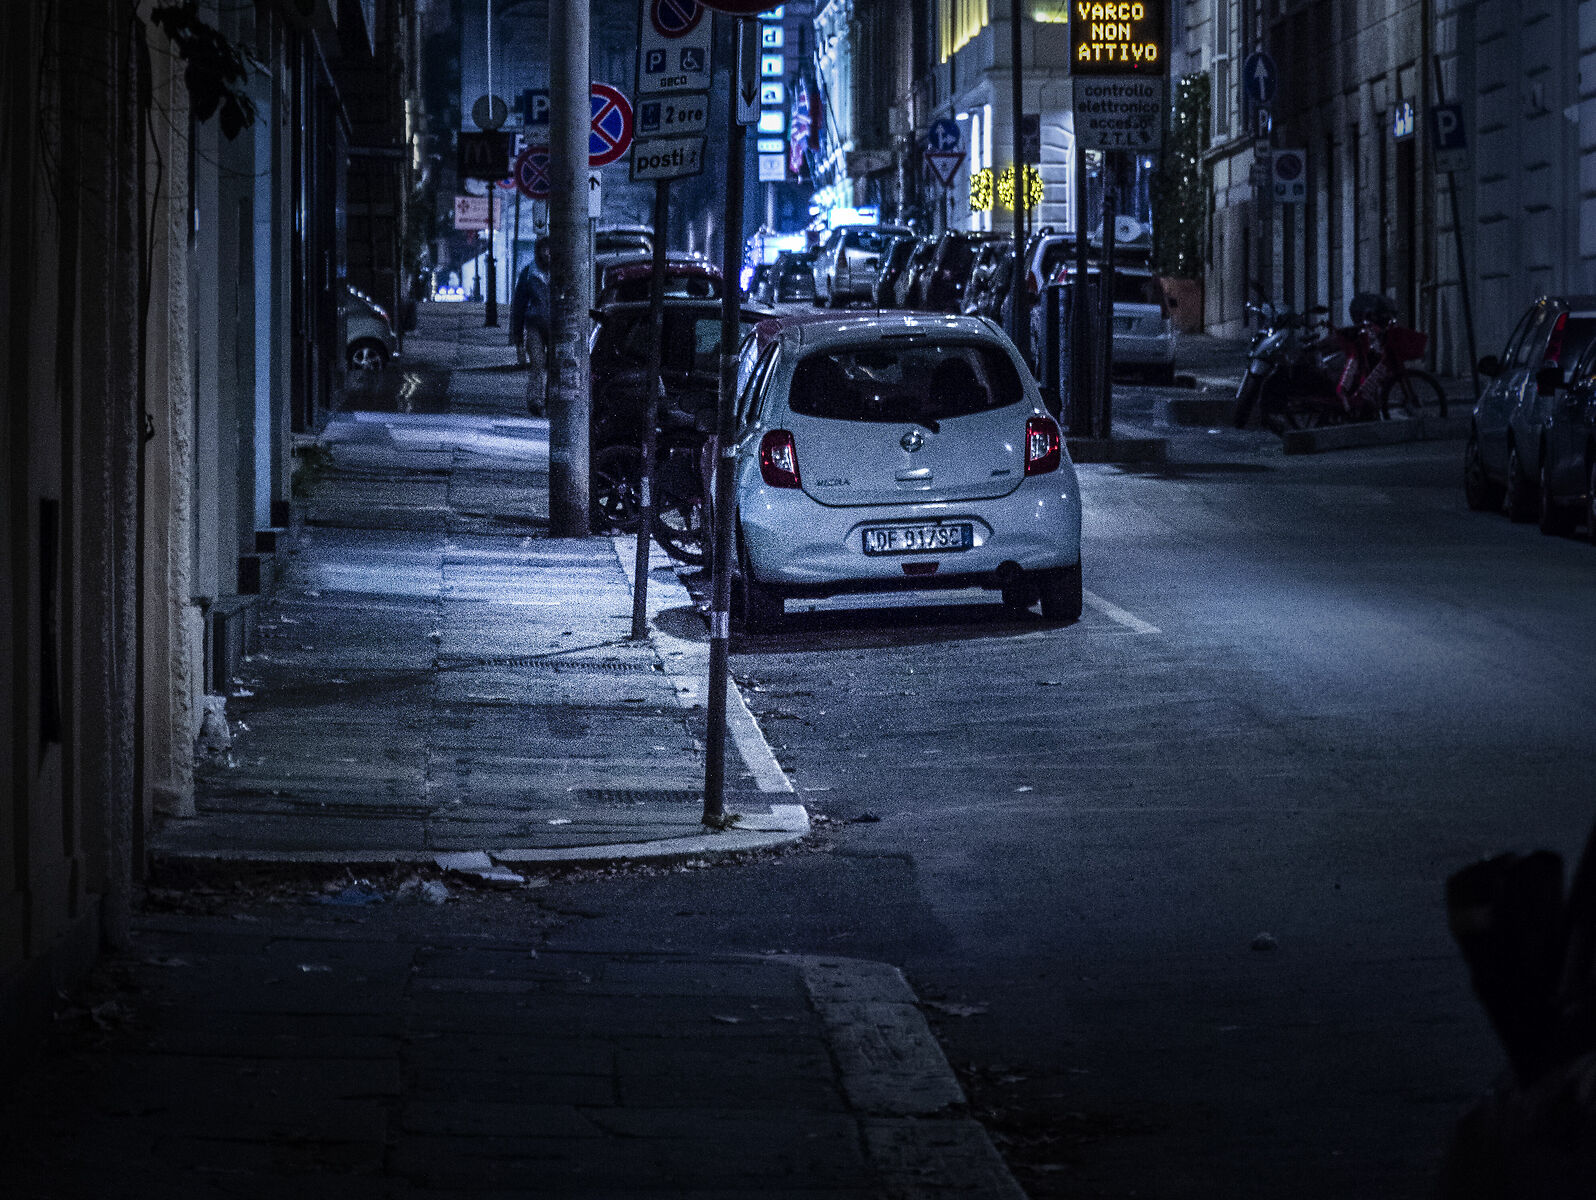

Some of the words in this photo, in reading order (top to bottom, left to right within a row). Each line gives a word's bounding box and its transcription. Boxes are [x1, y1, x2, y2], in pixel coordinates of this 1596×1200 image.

[1078, 2, 1145, 21] VARCO
[1092, 23, 1132, 41] NON
[1078, 43, 1158, 61] ATTIVO
[1085, 84, 1153, 97] controllo
[666, 106, 674, 124] 2
[678, 109, 703, 123] ore
[1078, 100, 1159, 112] elettronico
[637, 147, 684, 173] posti
